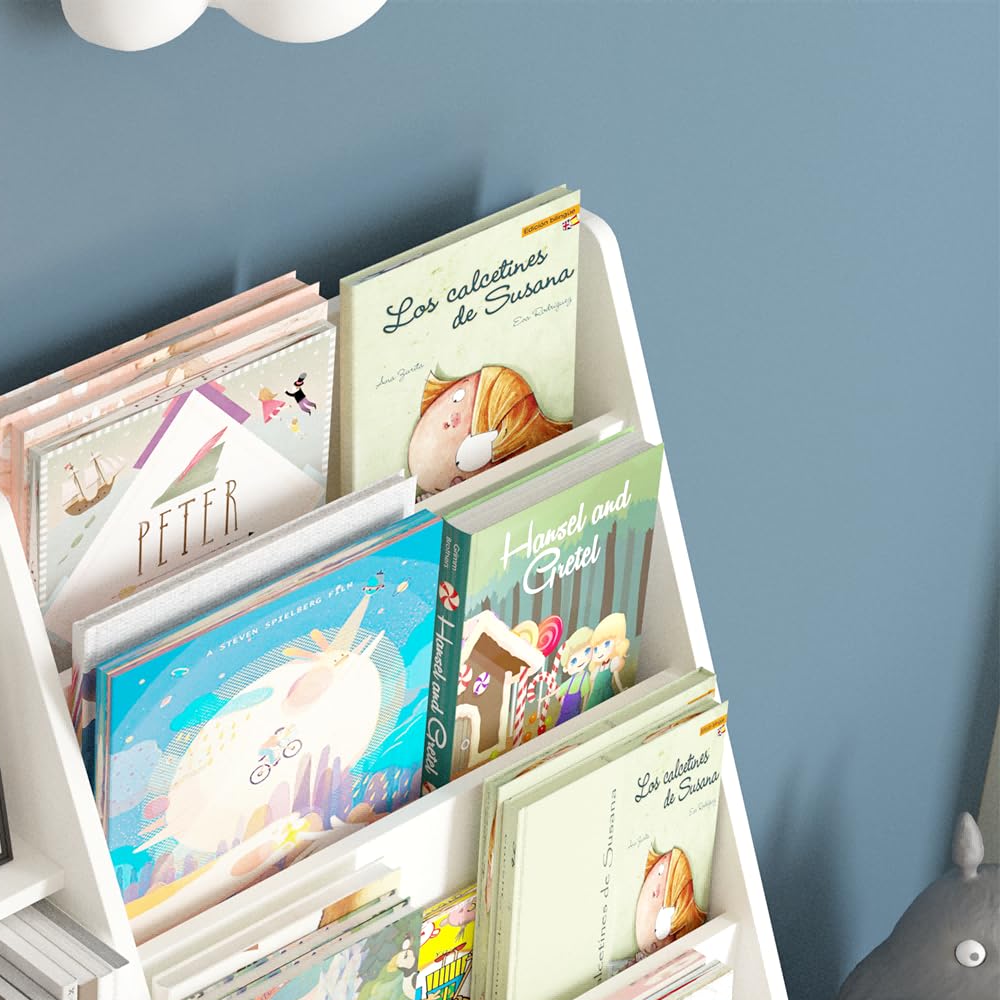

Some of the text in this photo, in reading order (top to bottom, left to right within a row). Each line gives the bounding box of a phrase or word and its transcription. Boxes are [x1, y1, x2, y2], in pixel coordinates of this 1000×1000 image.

[383, 248, 548, 334] Los calcetines
[452, 267, 575, 330] de Susana
[137, 479, 238, 576] PETER
[500, 480, 632, 570] Hansel and
[522, 534, 601, 595] Gretel
[206, 649, 214, 657] A
[219, 628, 258, 650] STEVEN
[264, 597, 322, 628] SPIELBERG
[424, 614, 455, 776] Hansel and Gretel
[635, 750, 710, 803] Los calcetines
[664, 788, 676, 809] de
[678, 771, 720, 802] Susana
[600, 788, 617, 899] de Susana
